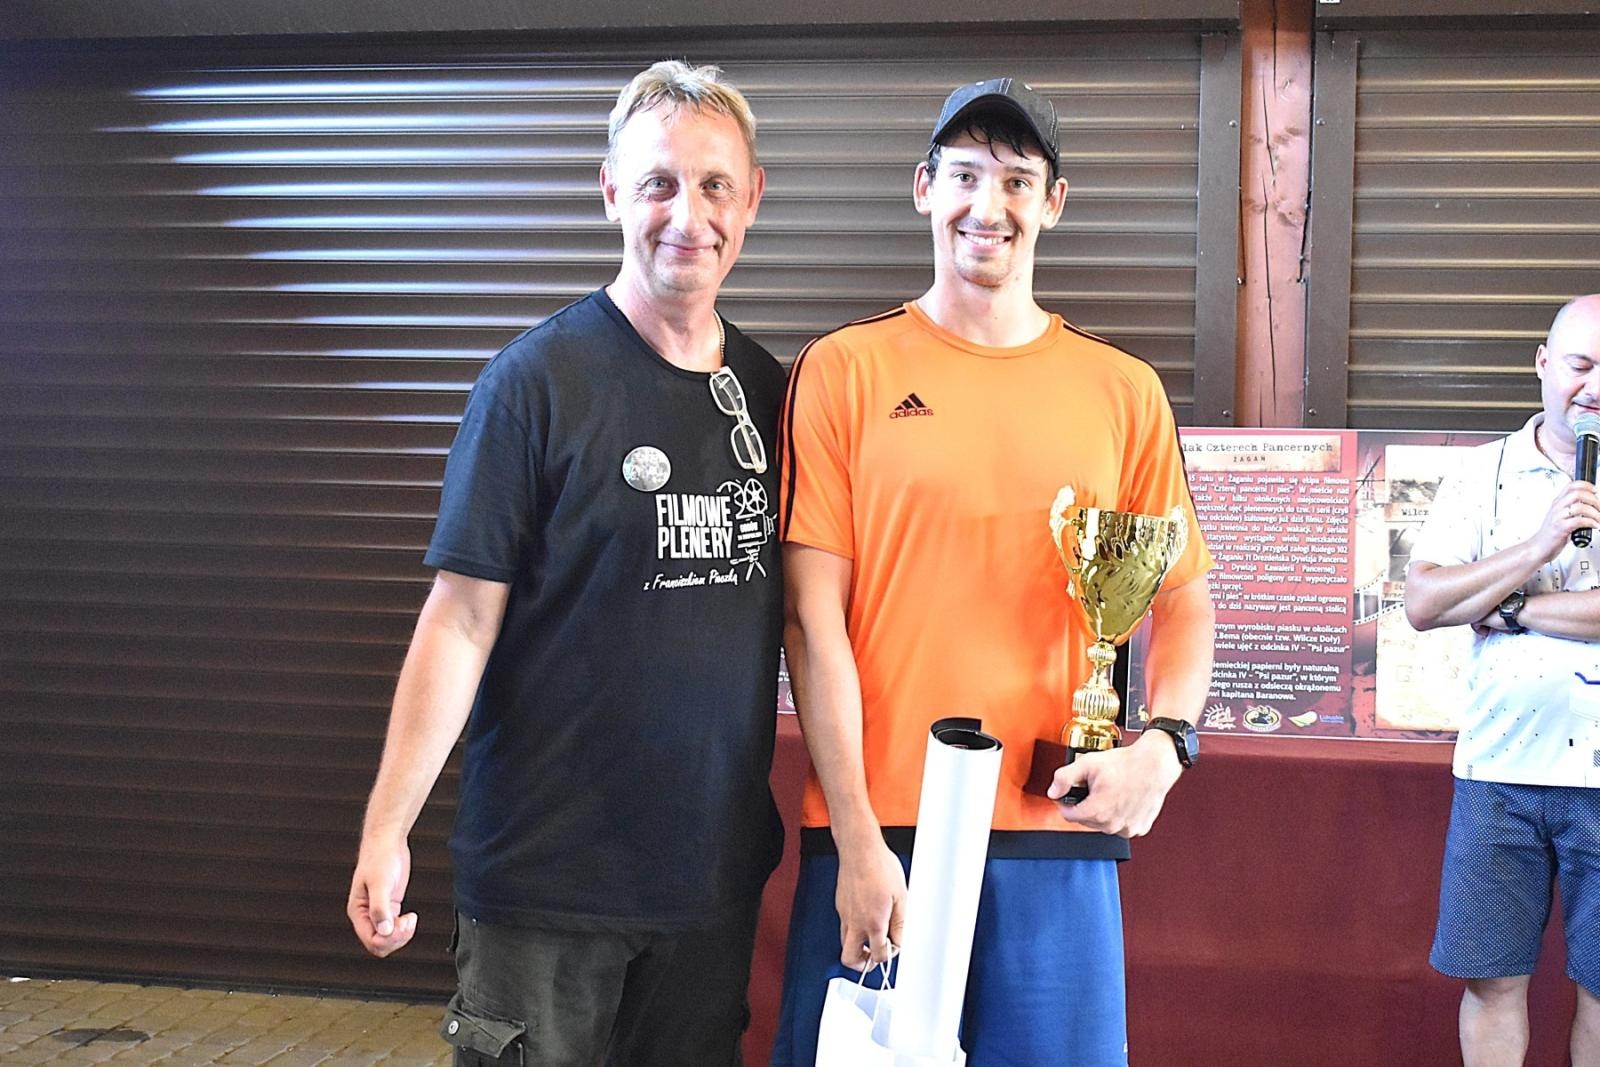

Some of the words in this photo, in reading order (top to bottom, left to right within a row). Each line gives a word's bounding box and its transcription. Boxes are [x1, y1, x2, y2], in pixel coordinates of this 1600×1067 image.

[889, 408, 933, 419] adidas
[1182, 443, 1202, 452] lak
[1206, 443, 1258, 452] Czterech
[1263, 443, 1333, 454] Pancernych
[1229, 474, 1253, 484] Żaganiu
[1258, 476, 1285, 484] pojawiła
[1289, 477, 1298, 485] się
[1302, 477, 1319, 485] ekipa
[1254, 496, 1290, 504] okolicznych
[1297, 496, 1349, 504] miejscowościach
[656, 494, 733, 526] FILMOWE
[1229, 505, 1241, 513] ujęć
[1244, 505, 1284, 514] plenerowych
[1401, 508, 1429, 516] Wilcz
[1244, 515, 1277, 523] kultowego
[1279, 515, 1288, 524] już
[1326, 516, 1348, 525] Zdjęcia
[657, 527, 733, 559] PLENERY
[1207, 534, 1237, 542] statystów
[1262, 545, 1288, 553] przygód
[1290, 545, 1309, 553] załogi
[1311, 546, 1335, 554] Rudego
[1218, 552, 1243, 562] Żaganiu
[1253, 554, 1289, 562] Drezdeńska
[1291, 555, 1317, 564] Dywizja
[1318, 556, 1348, 564] Pancerna
[1265, 564, 1294, 572] Kawalerii
[1257, 574, 1284, 582] poligony
[1306, 575, 1347, 584] wypożyczało
[643, 582, 650, 590] z
[1296, 595, 1316, 603] zyskał
[1318, 596, 1346, 604] ogromną
[1244, 604, 1277, 612] nazywany
[1279, 604, 1291, 612] jest
[1294, 605, 1322, 613] pancerną
[1325, 606, 1346, 614] stolicą
[1237, 624, 1275, 634] wyrobisku
[1277, 625, 1301, 634] piasku
[1312, 625, 1347, 634] okolicach
[1242, 633, 1273, 642] (obecnie
[1275, 634, 1292, 642] tzw.
[1293, 634, 1318, 643] Wilcze
[1319, 635, 1340, 644] Doły)
[1215, 642, 1235, 650] wiele
[1237, 643, 1252, 652] ujęć
[1260, 643, 1290, 651] odcinka
[1213, 661, 1250, 671] iemieckiej
[1252, 662, 1282, 671] papierni
[1284, 662, 1301, 672] były
[1302, 664, 1339, 674] naturalną
[1238, 671, 1247, 679] IV
[1309, 674, 1337, 683] którym
[1260, 682, 1293, 692] odsieczą
[1294, 683, 1341, 693] okrążonemu
[1222, 690, 1254, 700] kapitana
[1256, 691, 1296, 701] Baranowa.
